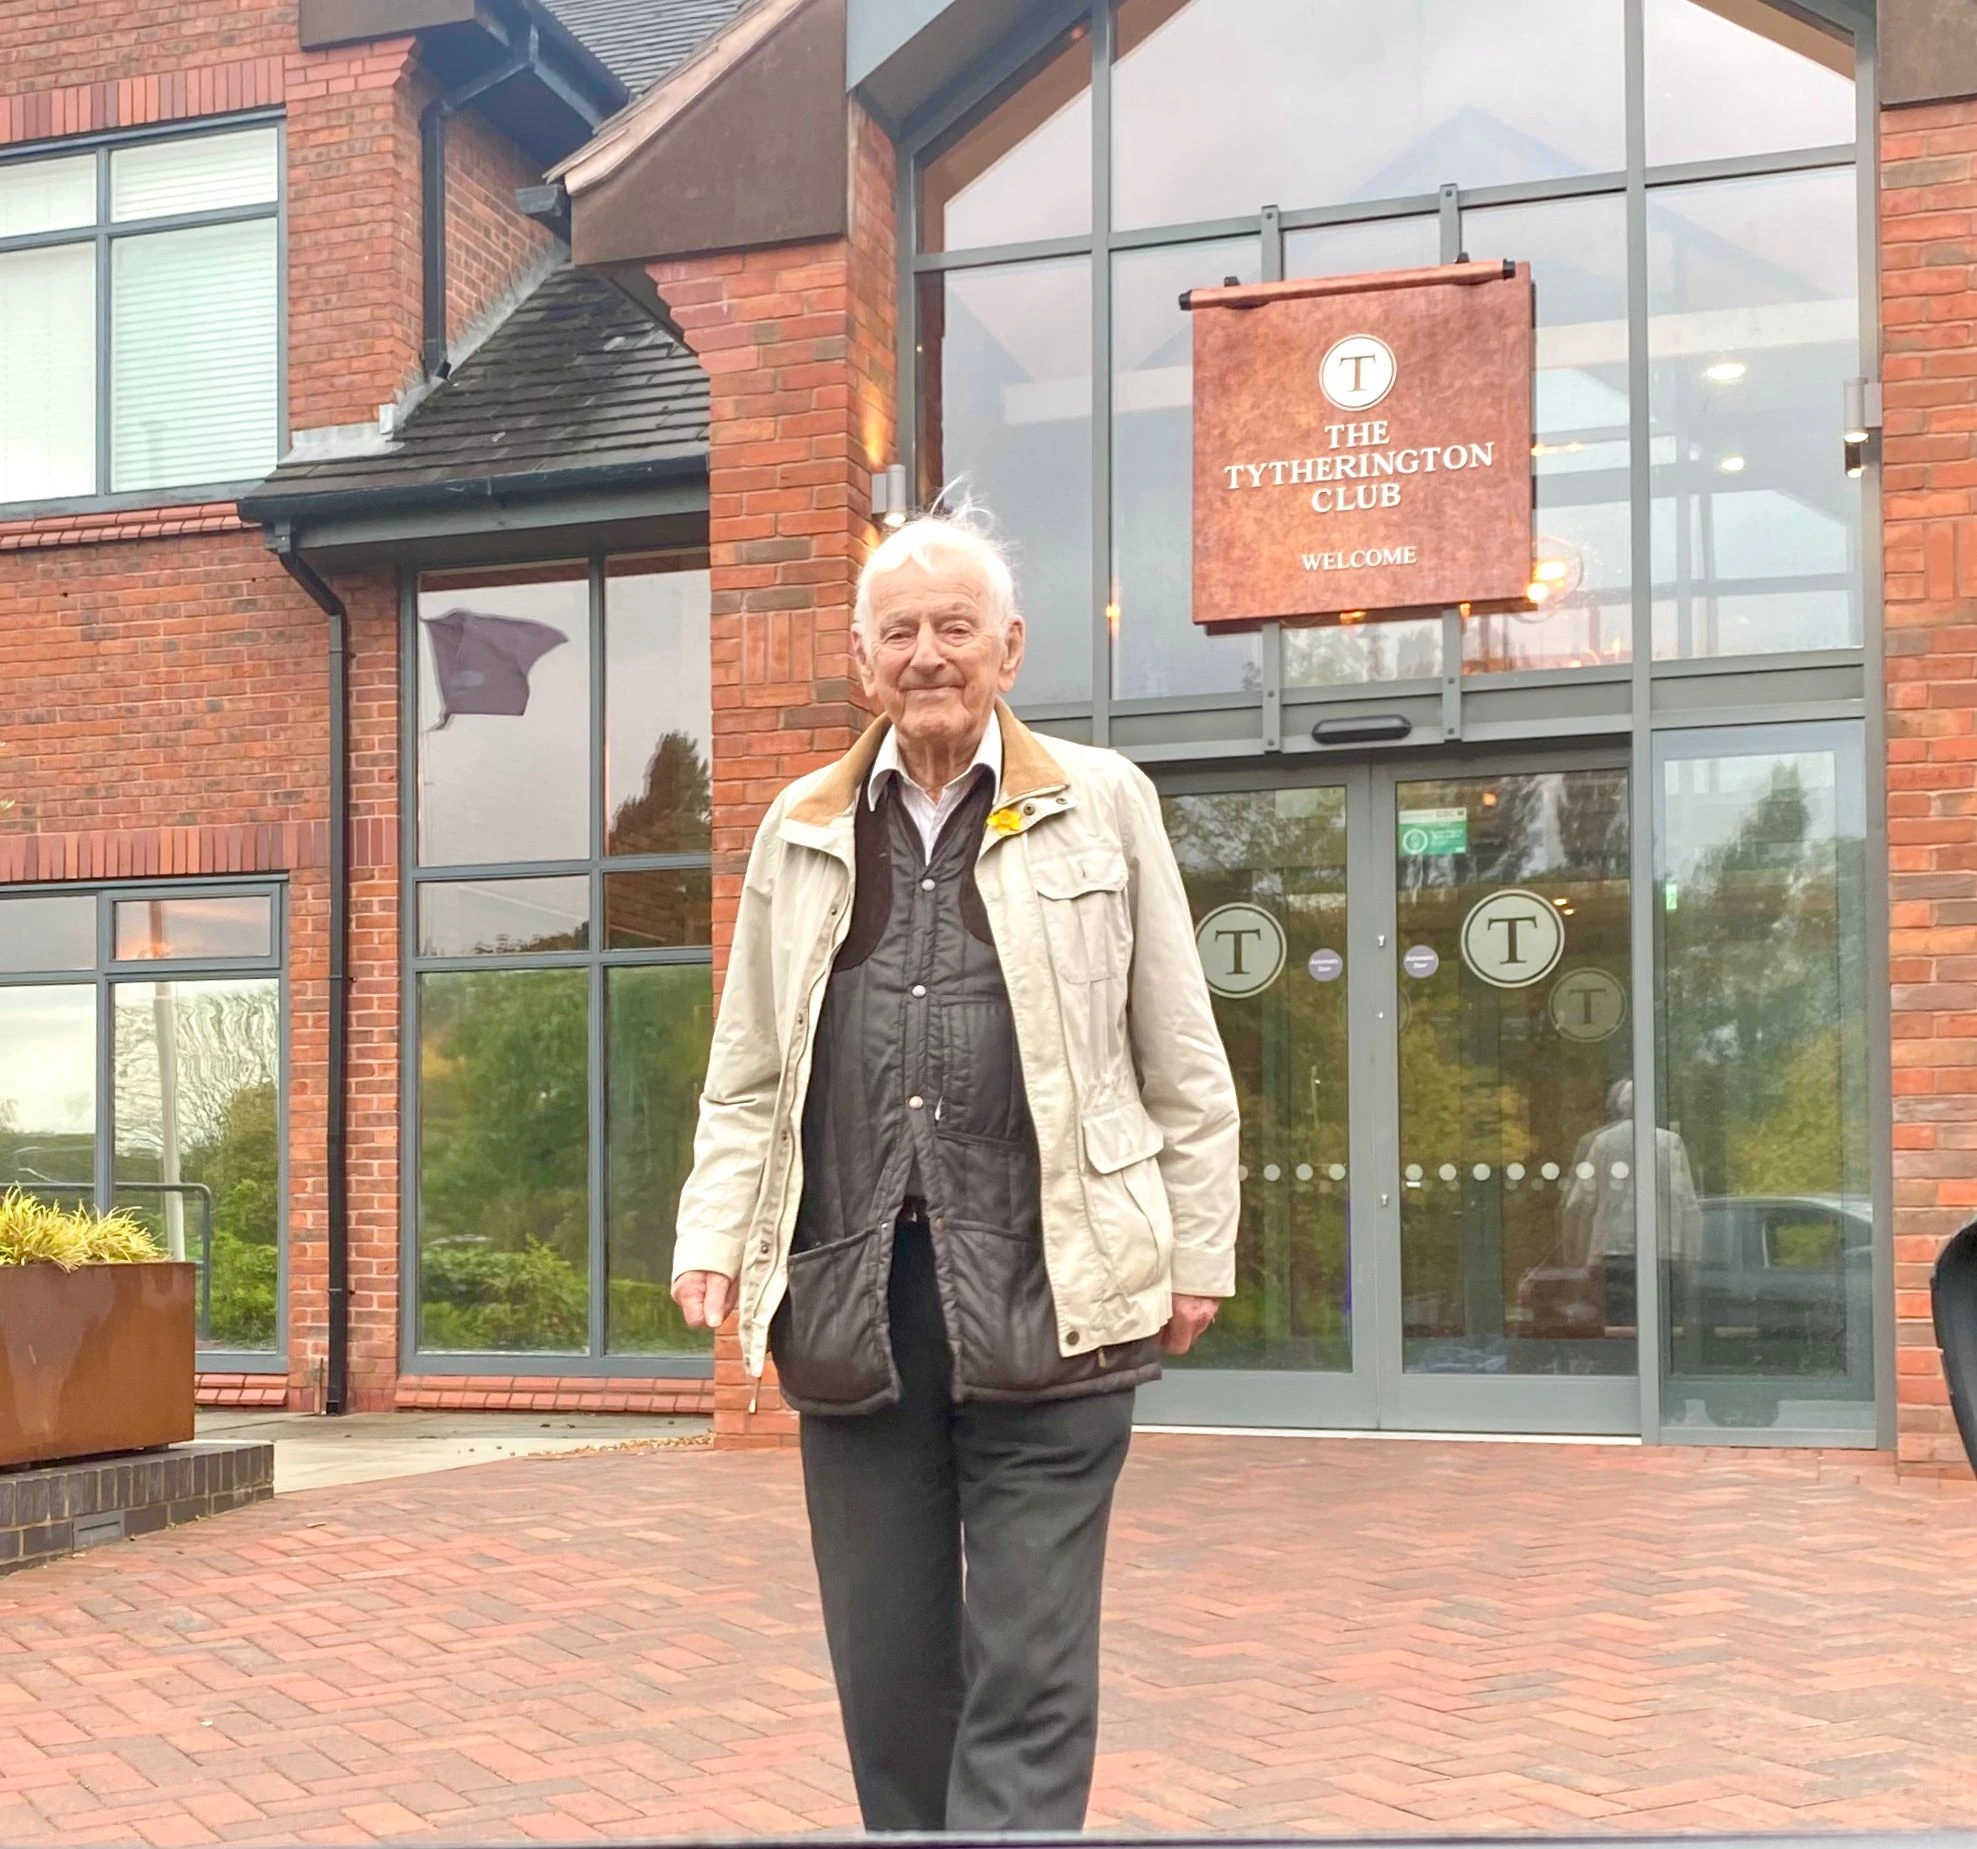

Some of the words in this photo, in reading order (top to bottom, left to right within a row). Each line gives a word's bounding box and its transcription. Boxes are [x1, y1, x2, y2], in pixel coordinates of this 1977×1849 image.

[1340, 353, 1376, 392] T
[1324, 420, 1390, 450] THE
[1224, 442, 1495, 489] TYTHERINGTON
[1311, 483, 1402, 513] CLUB
[1302, 545, 1417, 571] WELCOME
[1215, 928, 1262, 975] T
[1488, 915, 1538, 964] T
[1567, 987, 1607, 1025] T
